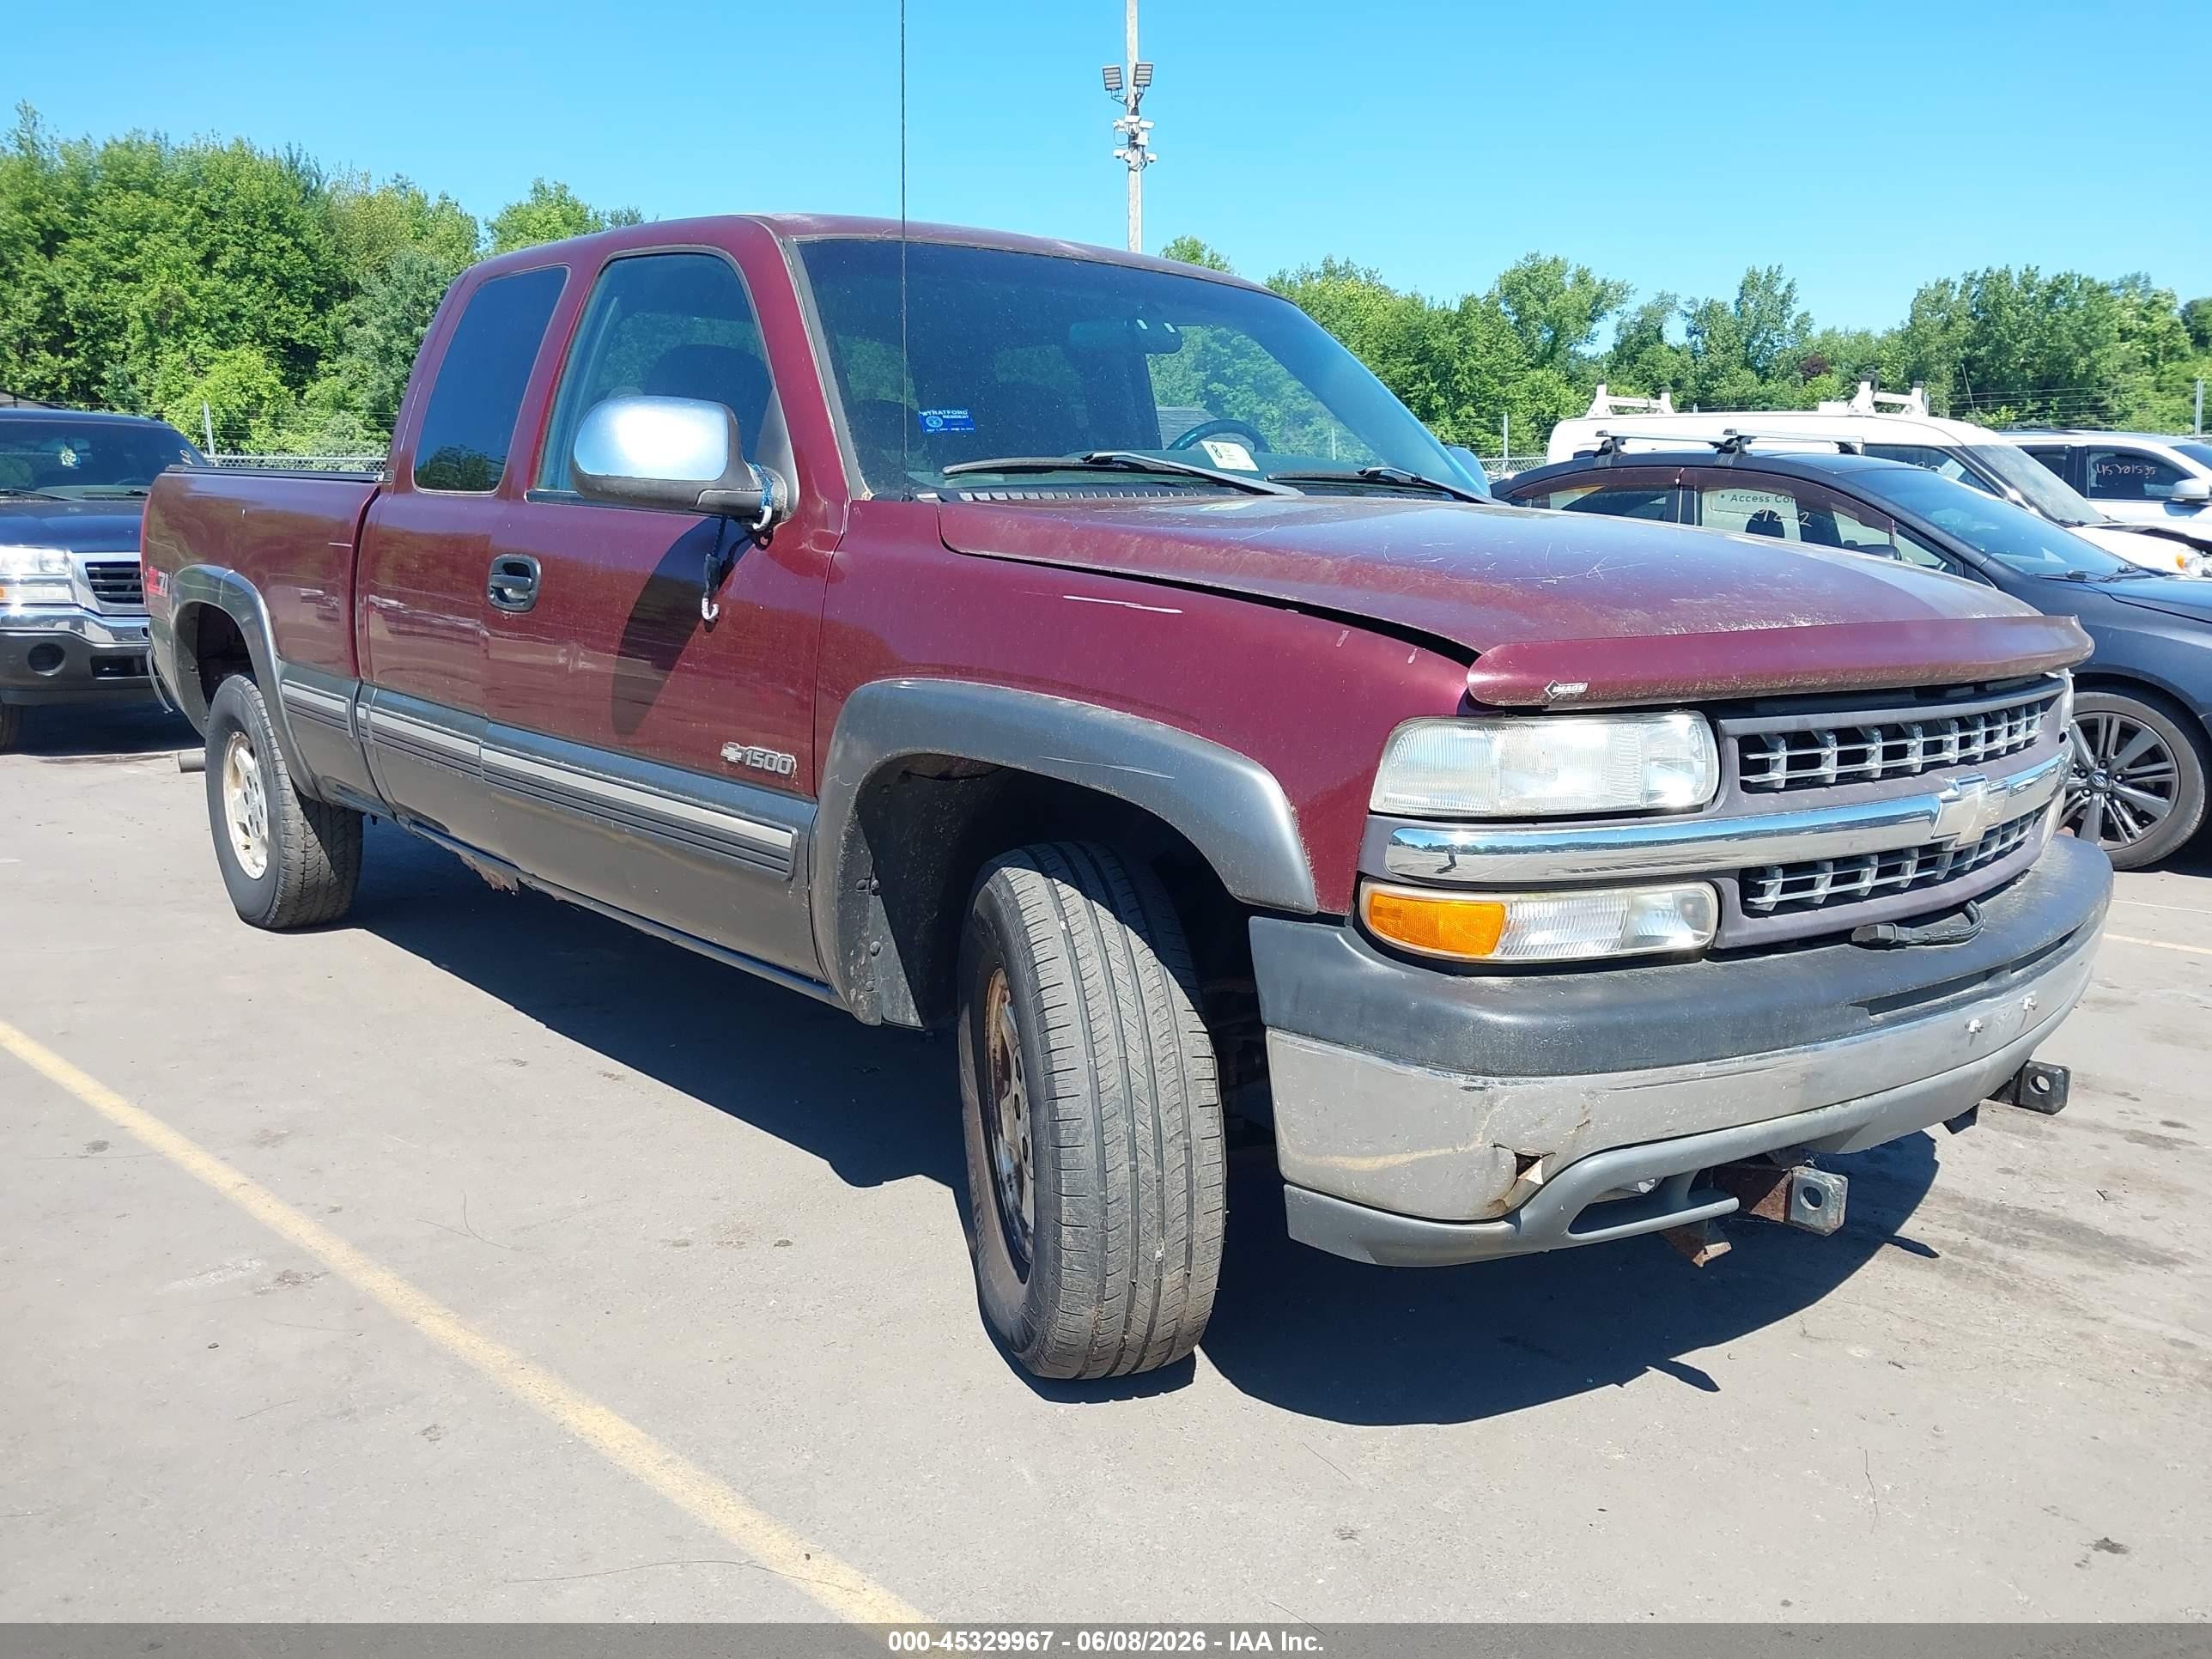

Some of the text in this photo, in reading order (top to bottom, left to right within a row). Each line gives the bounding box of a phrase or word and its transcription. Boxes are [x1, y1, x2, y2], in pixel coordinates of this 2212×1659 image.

[1729, 494, 1771, 503] Access
[148, 567, 169, 598] Z71
[1552, 684, 1587, 693] IMAGE
[745, 750, 793, 775] 1500
